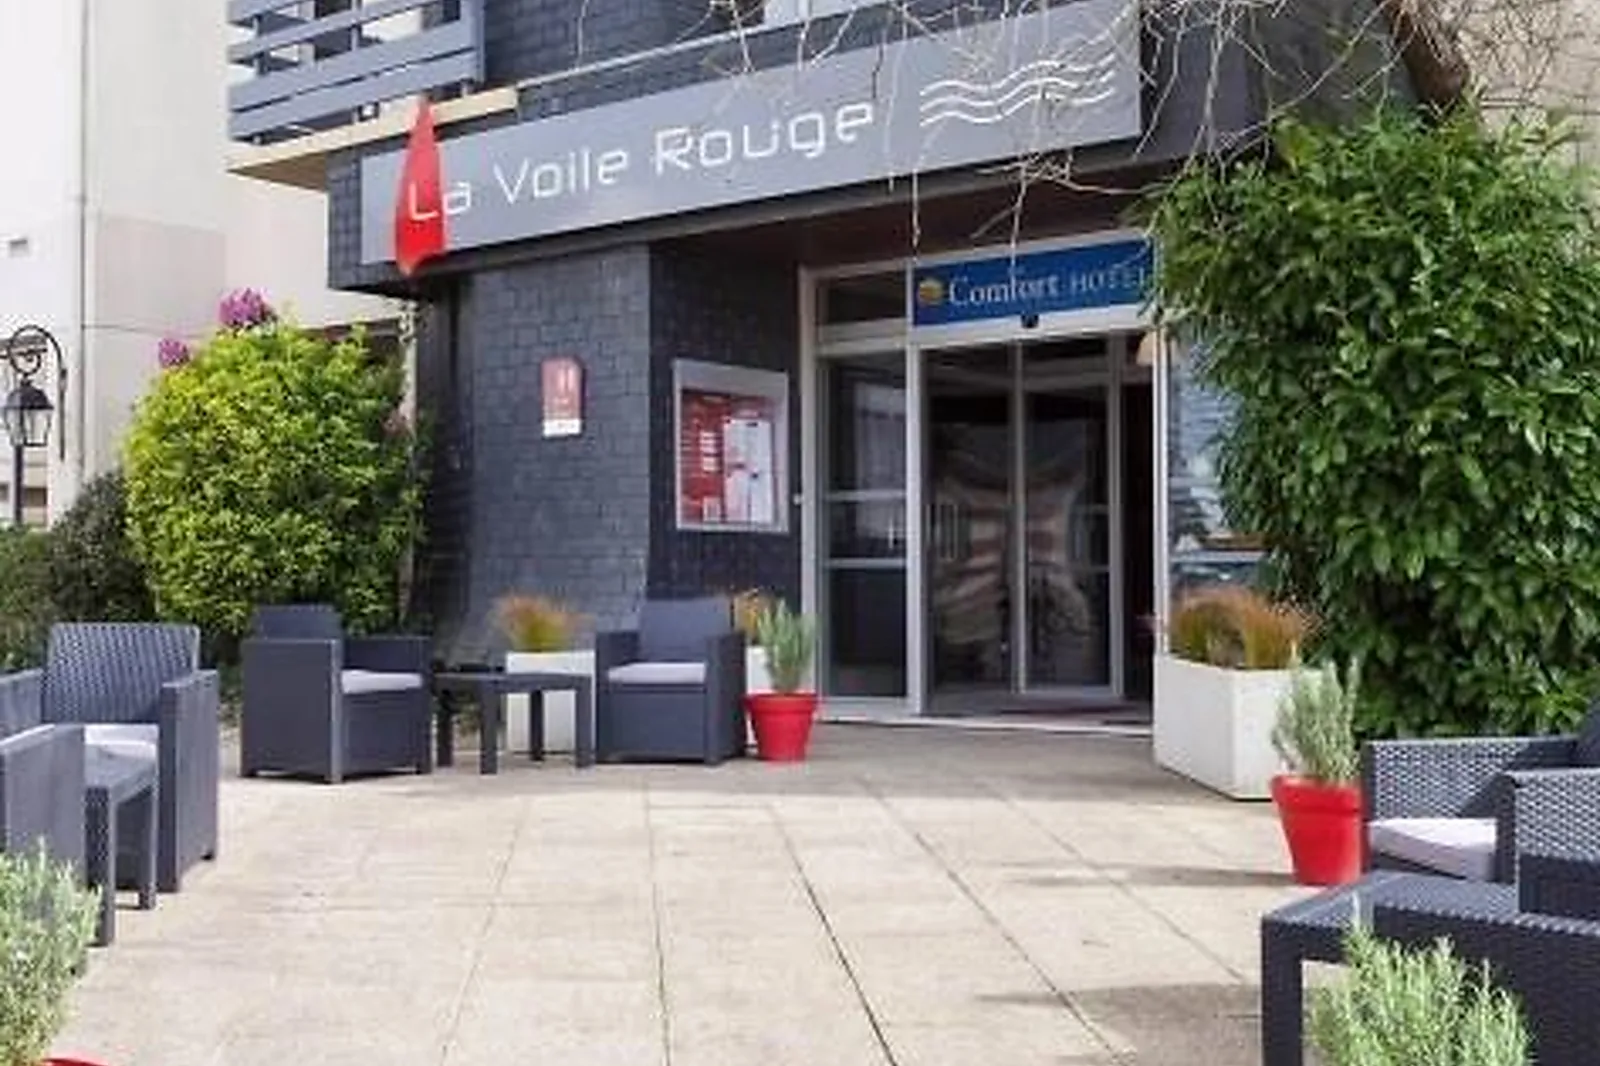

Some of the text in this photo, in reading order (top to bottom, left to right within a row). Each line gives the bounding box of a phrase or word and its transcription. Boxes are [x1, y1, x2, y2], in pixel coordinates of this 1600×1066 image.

[408, 102, 873, 220] La Voile Rouge
[949, 267, 1059, 307] Comfort
